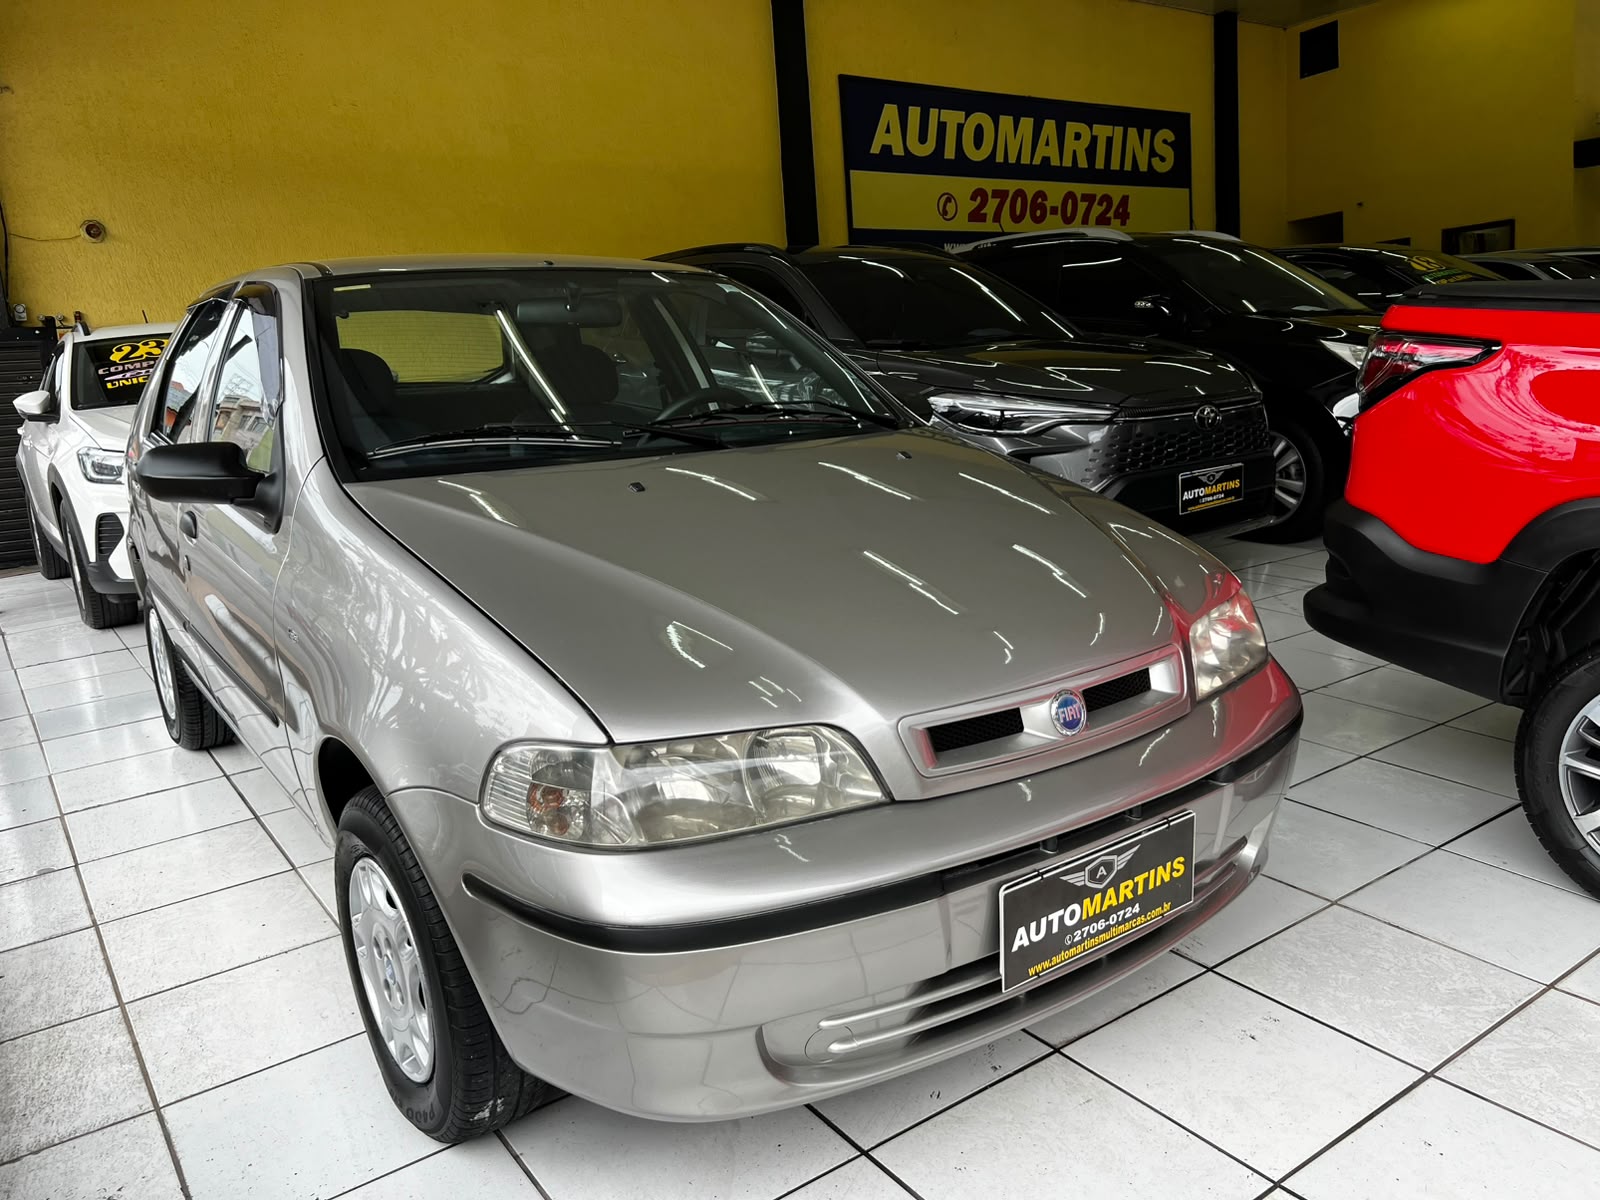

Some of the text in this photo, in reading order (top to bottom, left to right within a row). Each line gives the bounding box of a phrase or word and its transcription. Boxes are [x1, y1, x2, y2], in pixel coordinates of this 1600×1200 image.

[870, 103, 1176, 173] AUTOMARTINS
[967, 187, 1131, 226] 2706-0724
[111, 339, 167, 363] 23
[98, 360, 157, 375] COMP
[106, 376, 149, 389] UNIC
[1182, 479, 1240, 501] AUTOMARTINS
[1058, 703, 1081, 723] FIAT
[1096, 865, 1107, 879] A
[1011, 856, 1186, 952] AUTOMARTINS
[1073, 902, 1140, 942] 2706-0724
[1028, 901, 1172, 976] www.automartinsmultimarcas.com.br
